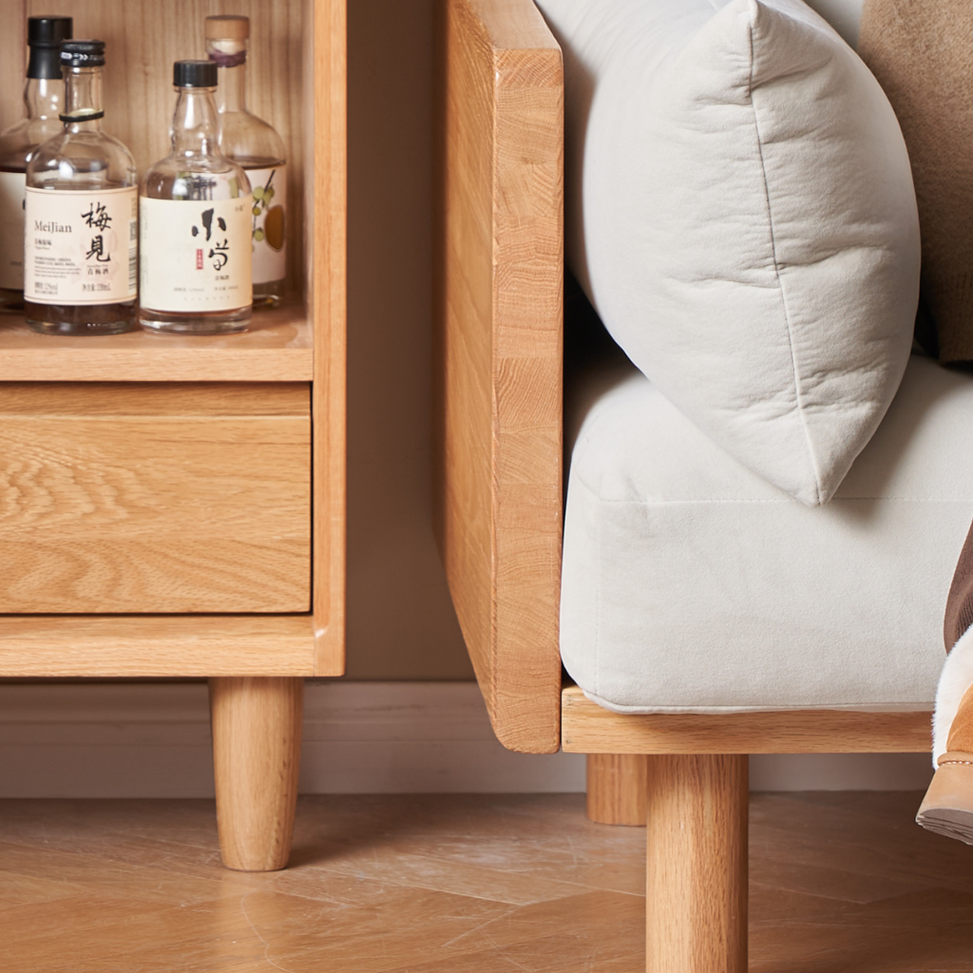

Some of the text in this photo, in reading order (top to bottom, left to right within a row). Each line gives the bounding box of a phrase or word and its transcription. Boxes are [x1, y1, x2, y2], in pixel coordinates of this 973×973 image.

[34, 220, 73, 234] MeiJian
[87, 268, 110, 276] 青梅酒
